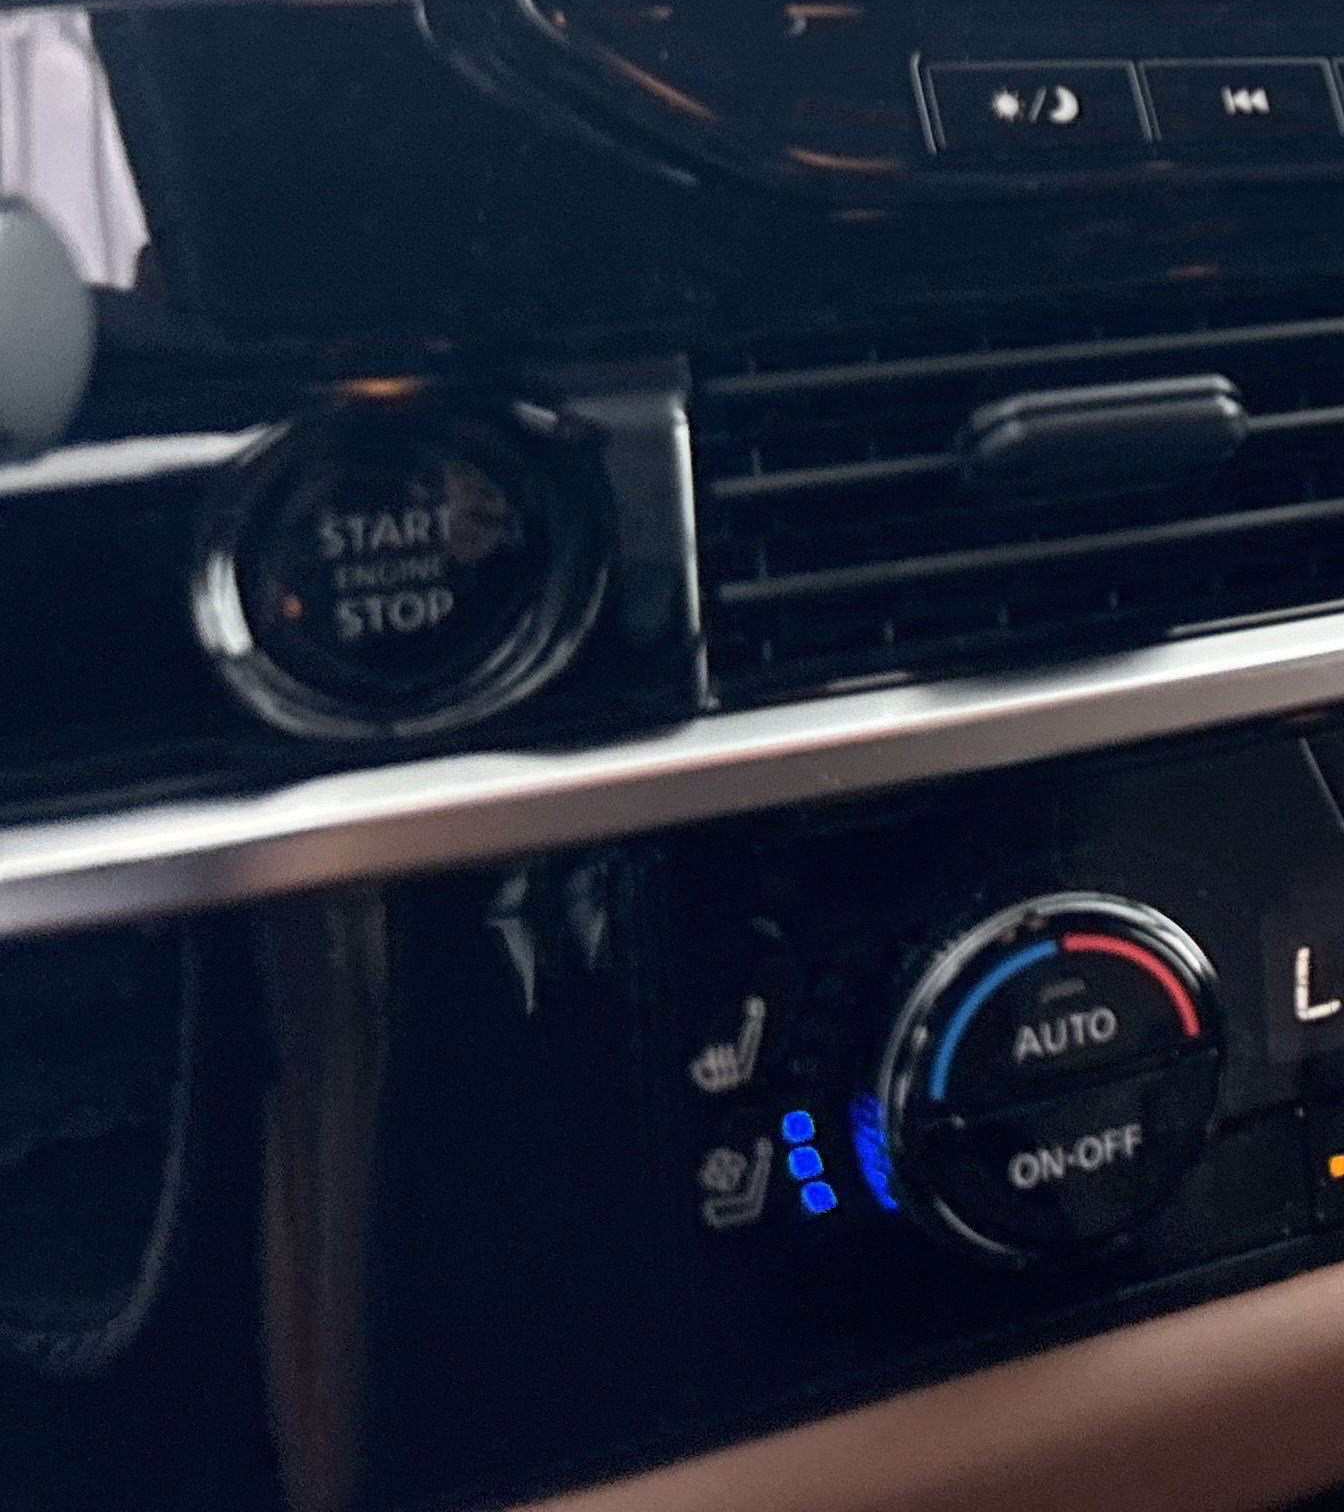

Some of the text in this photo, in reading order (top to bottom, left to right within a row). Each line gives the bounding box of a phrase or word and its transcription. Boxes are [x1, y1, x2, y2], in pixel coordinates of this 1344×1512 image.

[319, 505, 453, 558] START
[337, 589, 454, 639] STOP
[1012, 1007, 1119, 1064] AUTO
